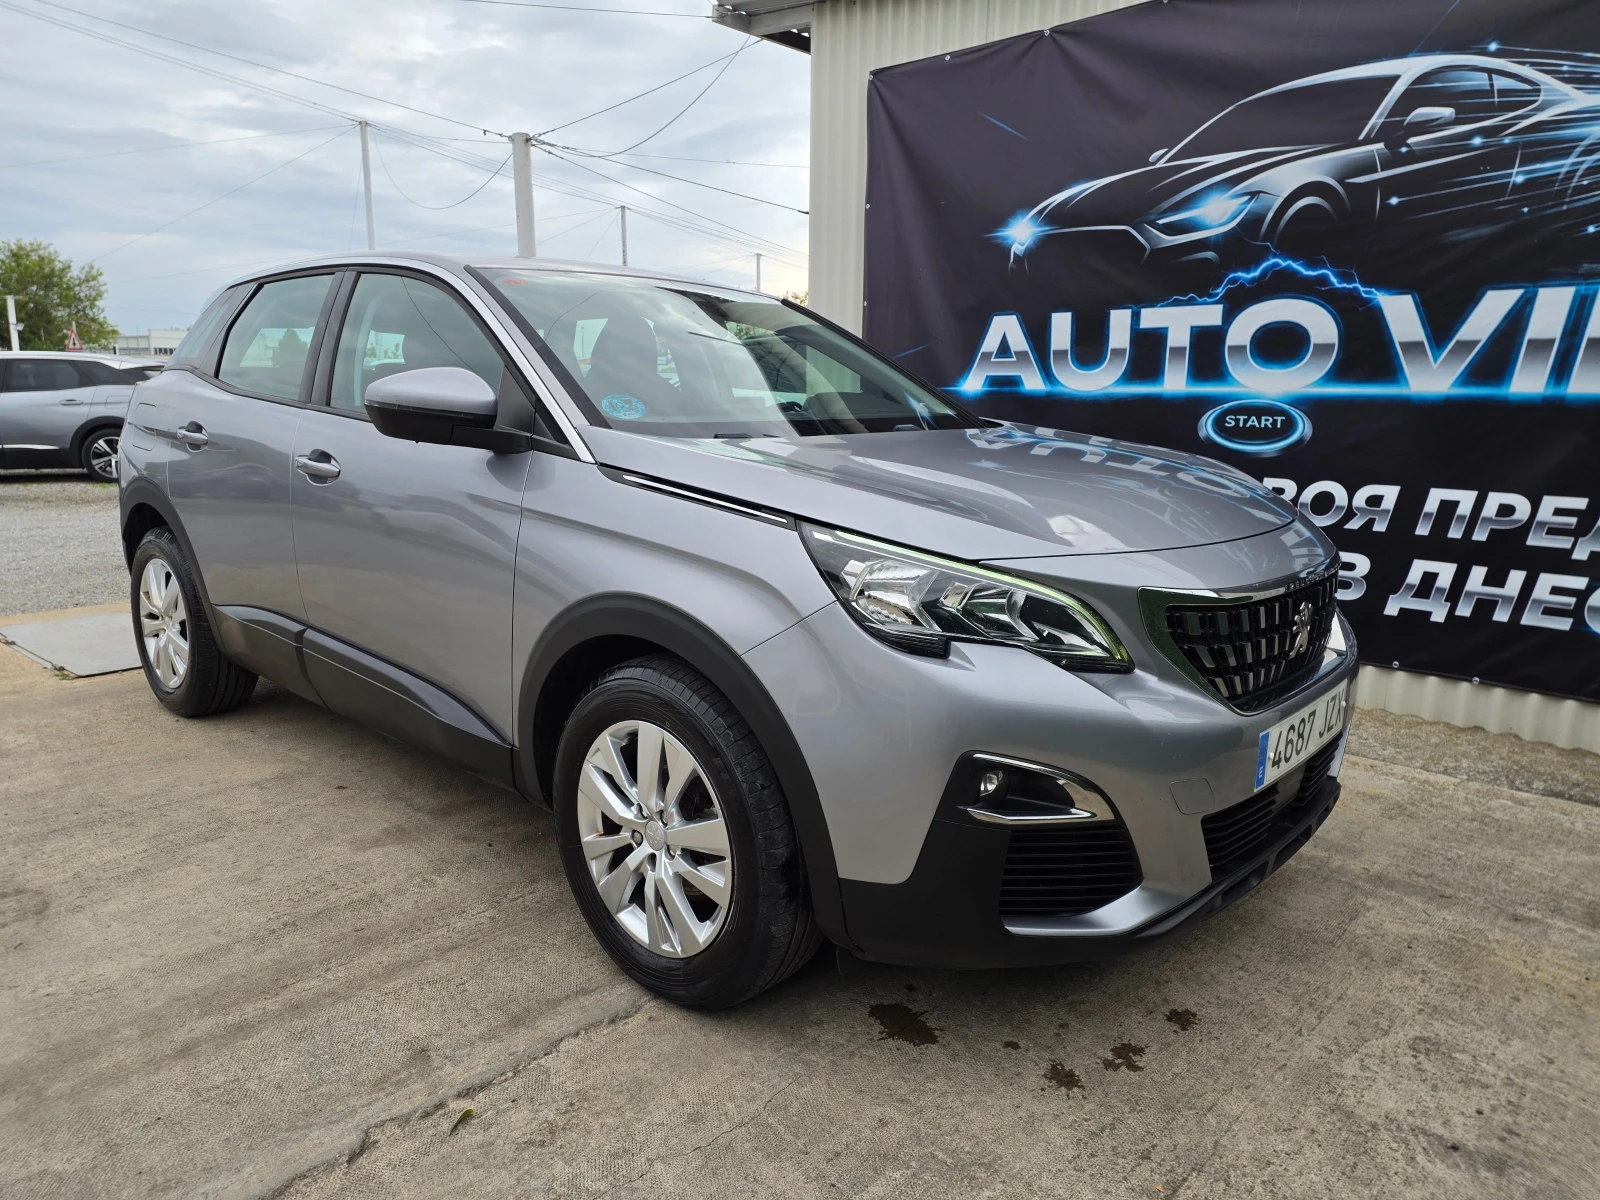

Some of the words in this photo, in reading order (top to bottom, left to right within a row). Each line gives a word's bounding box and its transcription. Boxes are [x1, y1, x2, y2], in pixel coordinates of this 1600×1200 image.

[962, 299, 1339, 392] AUTO
[1224, 415, 1286, 429] START
[1271, 709, 1317, 769] 4687
